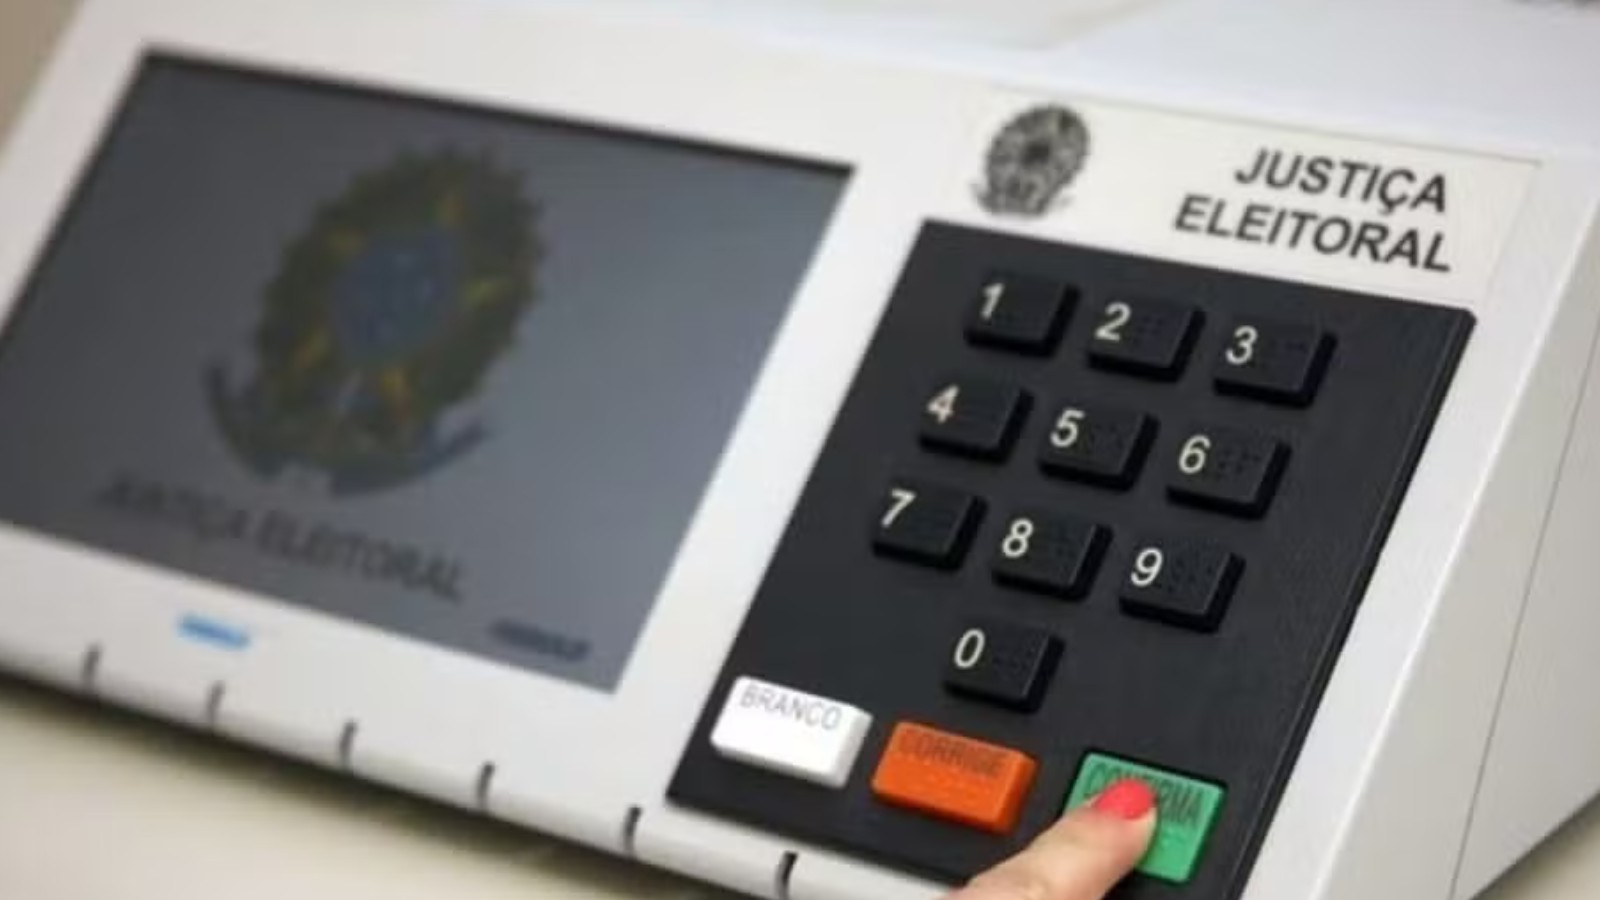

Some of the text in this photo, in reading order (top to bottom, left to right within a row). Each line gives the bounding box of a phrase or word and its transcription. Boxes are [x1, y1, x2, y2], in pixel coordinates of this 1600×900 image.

[1234, 147, 1448, 214] JUSTIÇA
[1173, 193, 1451, 273] ELEITORAL
[982, 283, 1003, 318] 1
[1095, 302, 1131, 341] 2
[1225, 325, 1258, 365] 3
[928, 386, 958, 422] 4
[1050, 408, 1084, 448] 5
[1178, 435, 1211, 474] 6
[882, 489, 916, 526] 7
[1001, 518, 1034, 558] 8
[1130, 547, 1163, 587] 9
[954, 629, 985, 669] 0
[739, 682, 842, 730] BRANCO
[1081, 760, 1204, 828] CORMA
